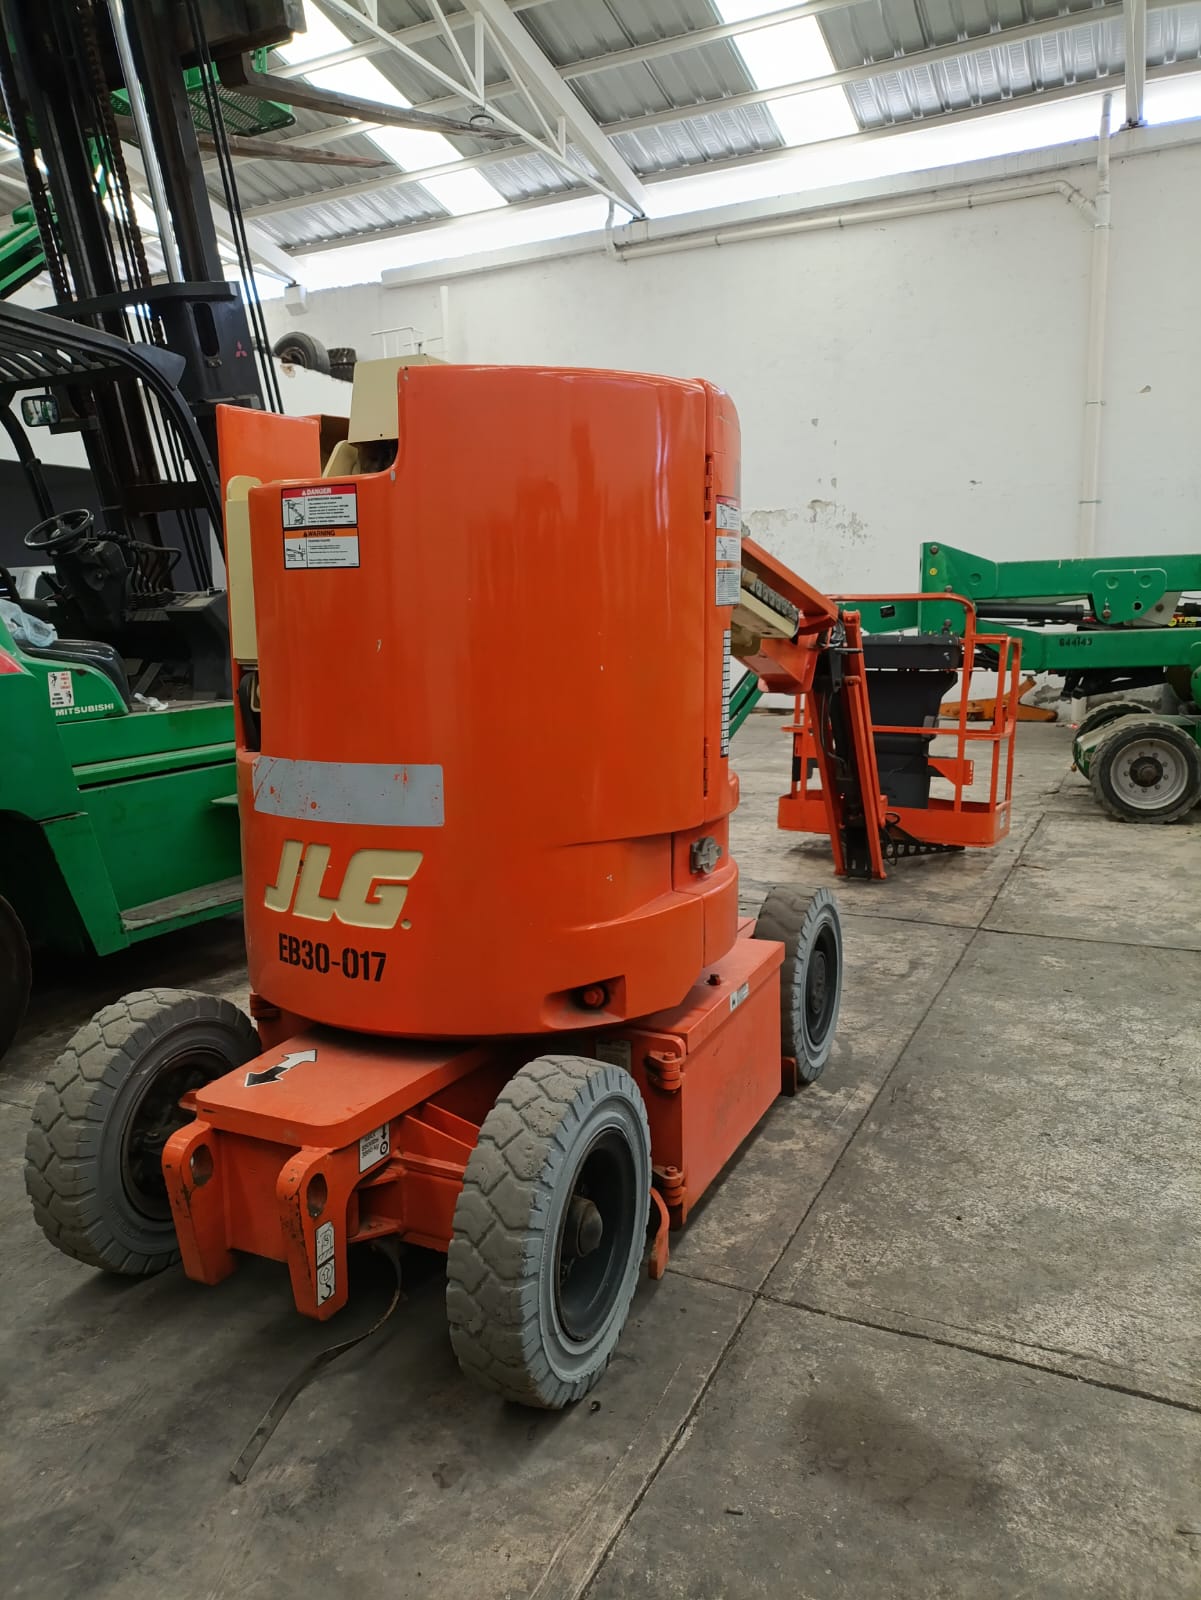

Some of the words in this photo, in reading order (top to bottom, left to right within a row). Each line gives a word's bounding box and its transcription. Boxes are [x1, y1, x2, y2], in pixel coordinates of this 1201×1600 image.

[306, 487, 332, 496] DANGER
[55, 703, 115, 716] MITSUBISHI
[264, 839, 424, 930] JLG
[278, 933, 387, 982] EB30-017
